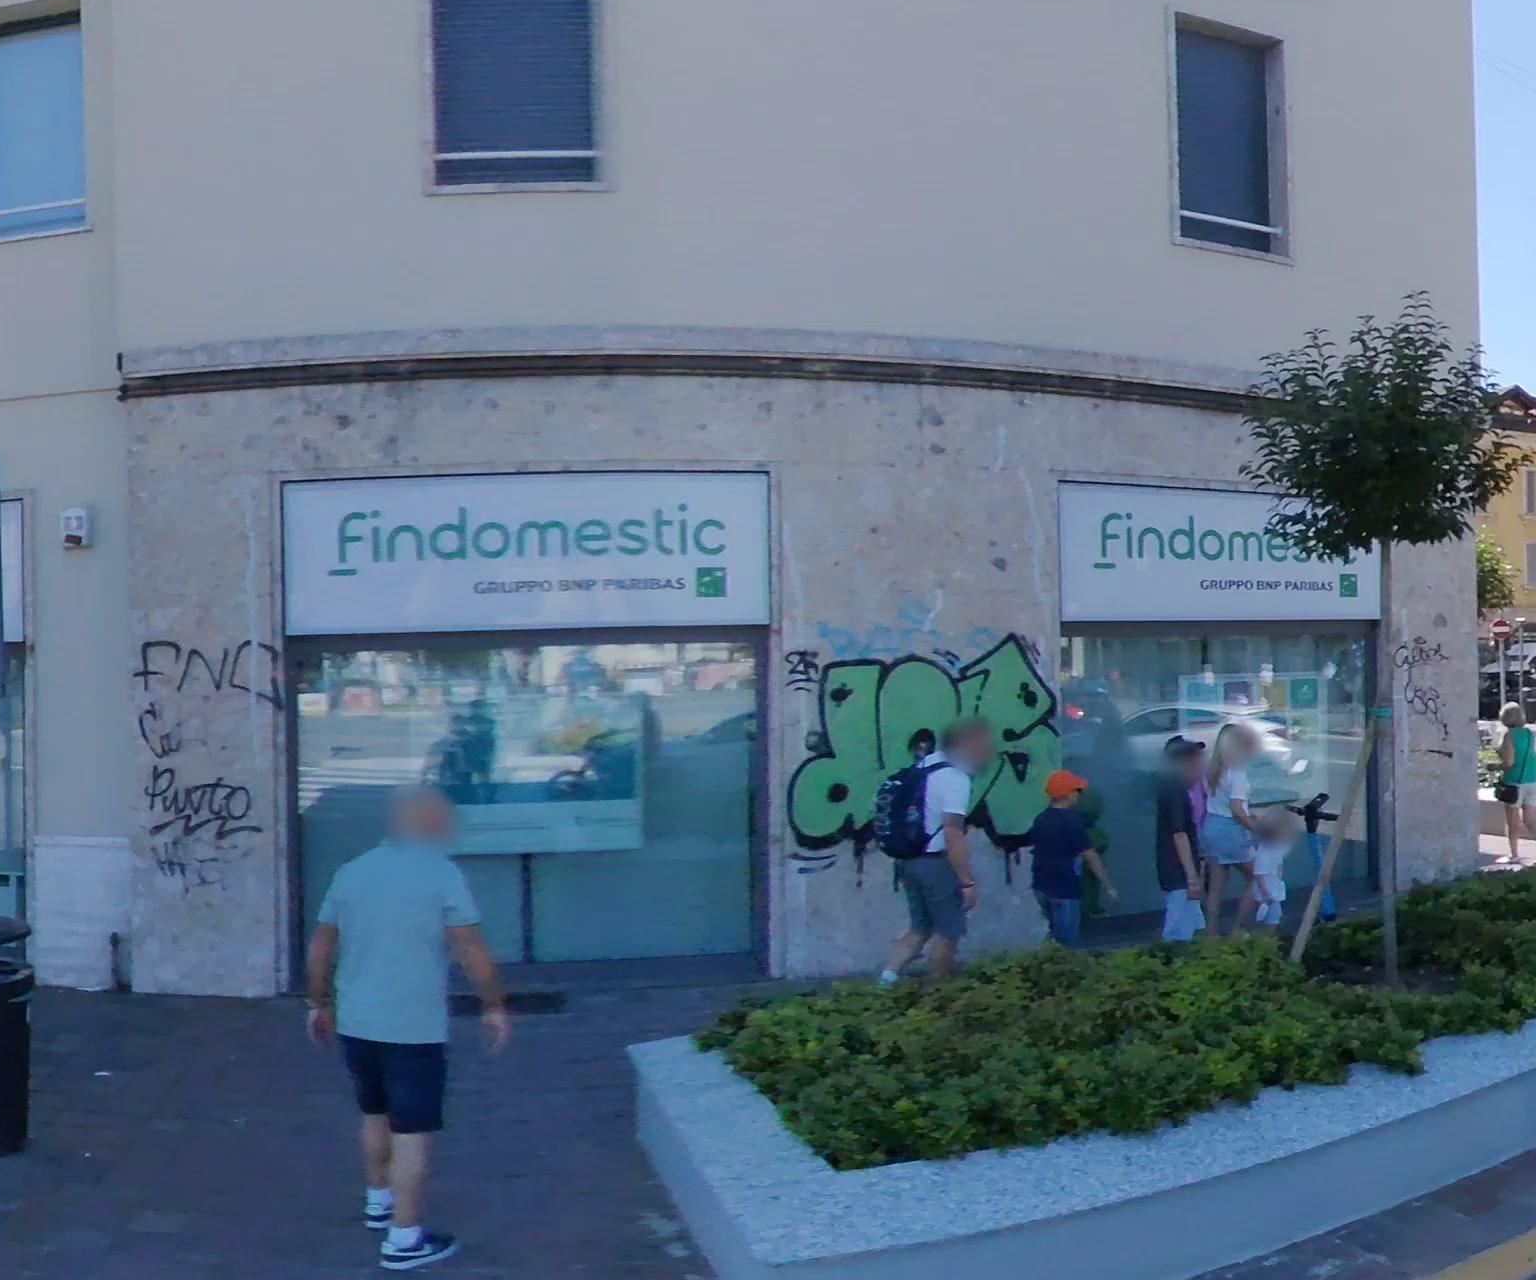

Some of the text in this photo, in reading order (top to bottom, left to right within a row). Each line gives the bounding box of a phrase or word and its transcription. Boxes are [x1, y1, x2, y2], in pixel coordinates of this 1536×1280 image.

[472, 577, 686, 594] GRUPPO BNP PARIBAS
[1199, 579, 1334, 592] GRUPPO BNP PARIBAS
